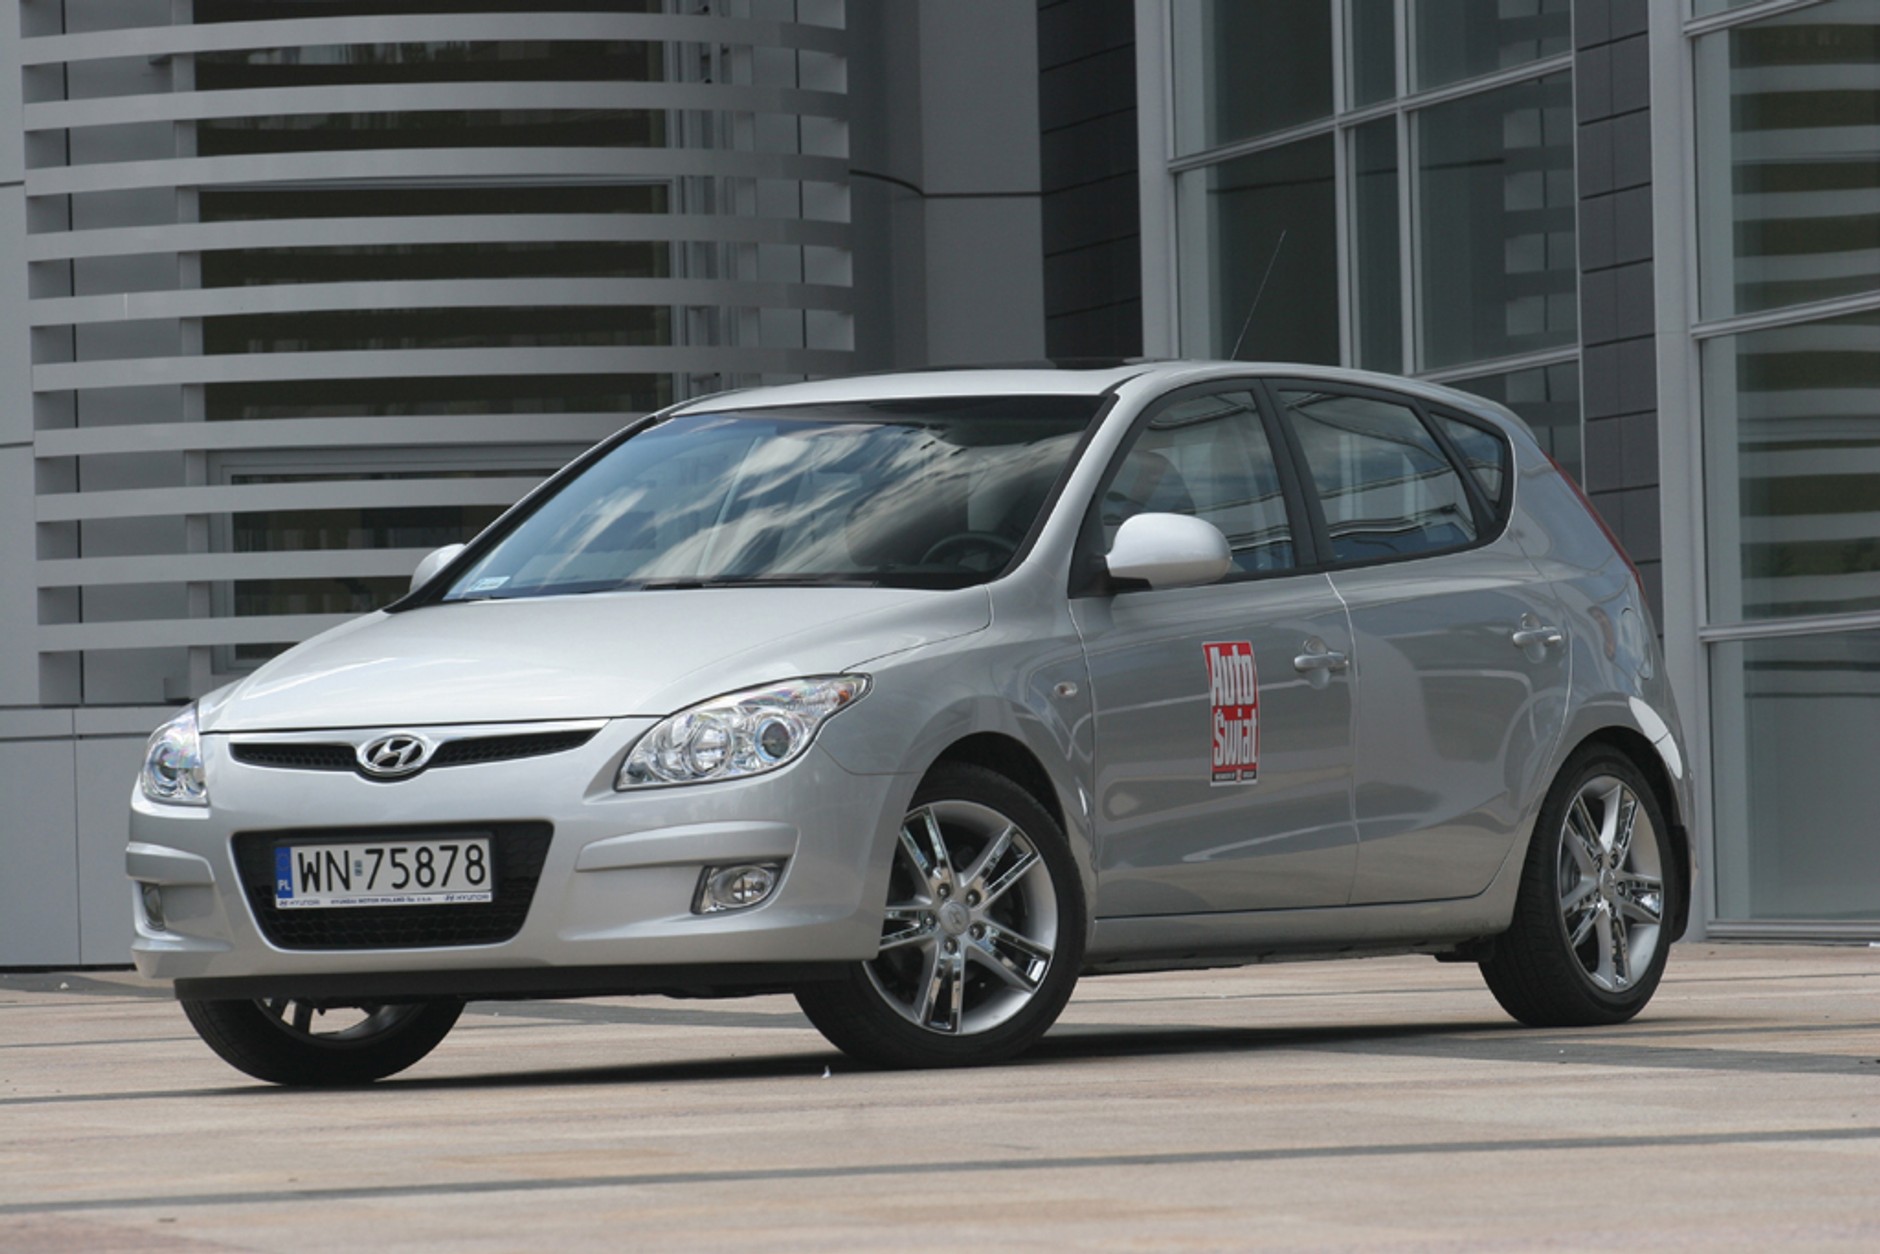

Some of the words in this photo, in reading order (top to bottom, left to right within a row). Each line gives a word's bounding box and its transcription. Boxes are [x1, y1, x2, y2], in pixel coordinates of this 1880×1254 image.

[1209, 644, 1254, 706] Auto
[277, 879, 291, 891] PL
[298, 849, 352, 894] WN
[364, 844, 486, 890] 75878
